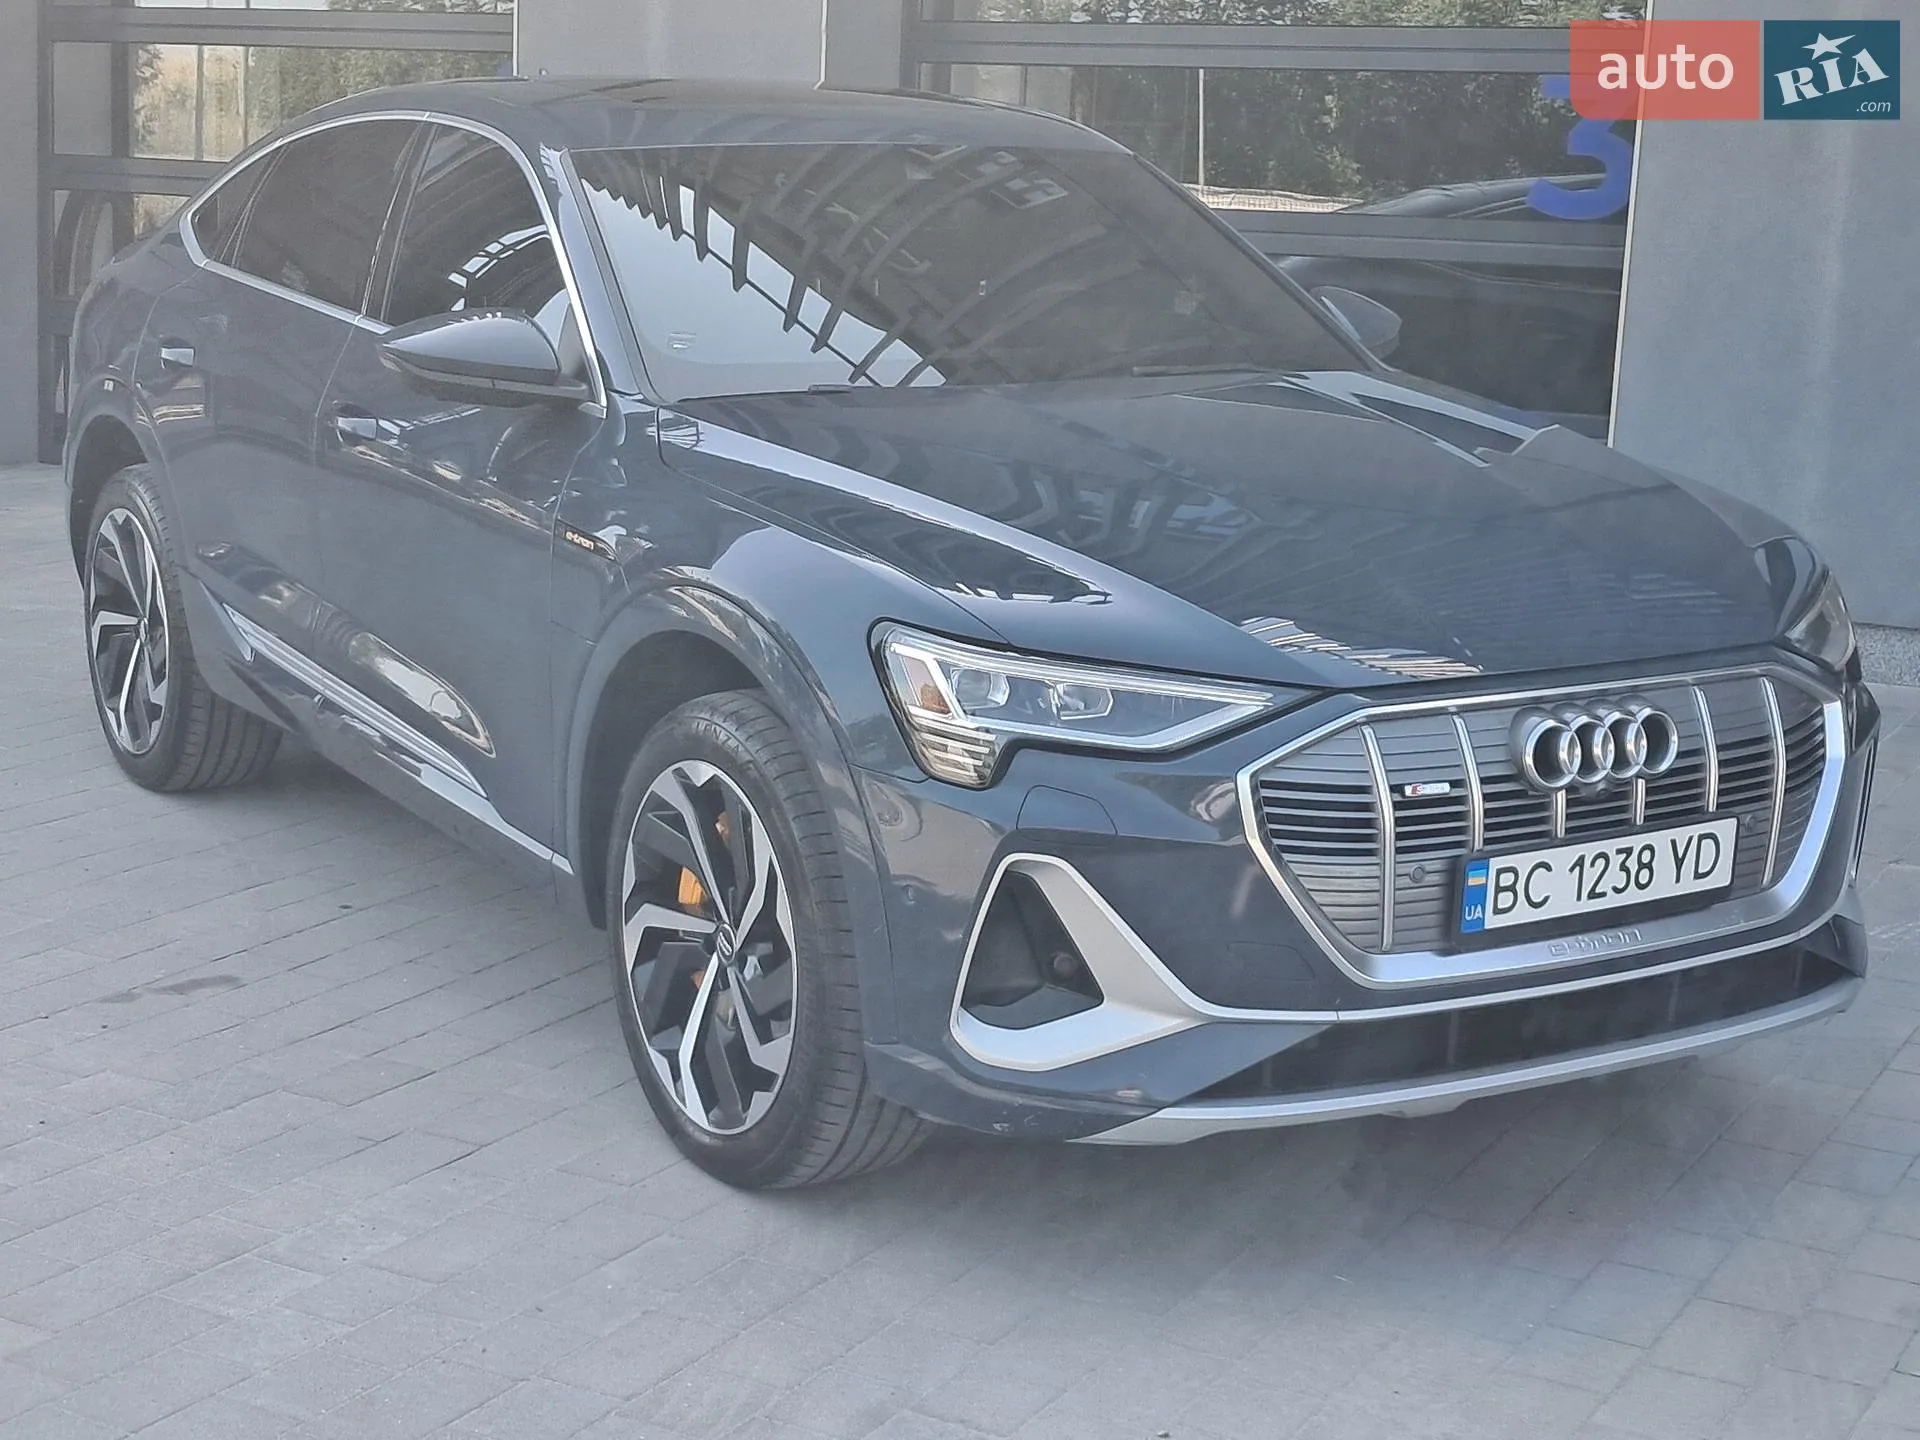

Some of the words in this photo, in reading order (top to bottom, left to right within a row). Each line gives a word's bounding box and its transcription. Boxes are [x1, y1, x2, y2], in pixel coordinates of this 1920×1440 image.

[1492, 860, 1553, 916] BC
[1568, 843, 1656, 902] 1238
[1669, 832, 1721, 884] YD
[1464, 903, 1483, 921] UA
